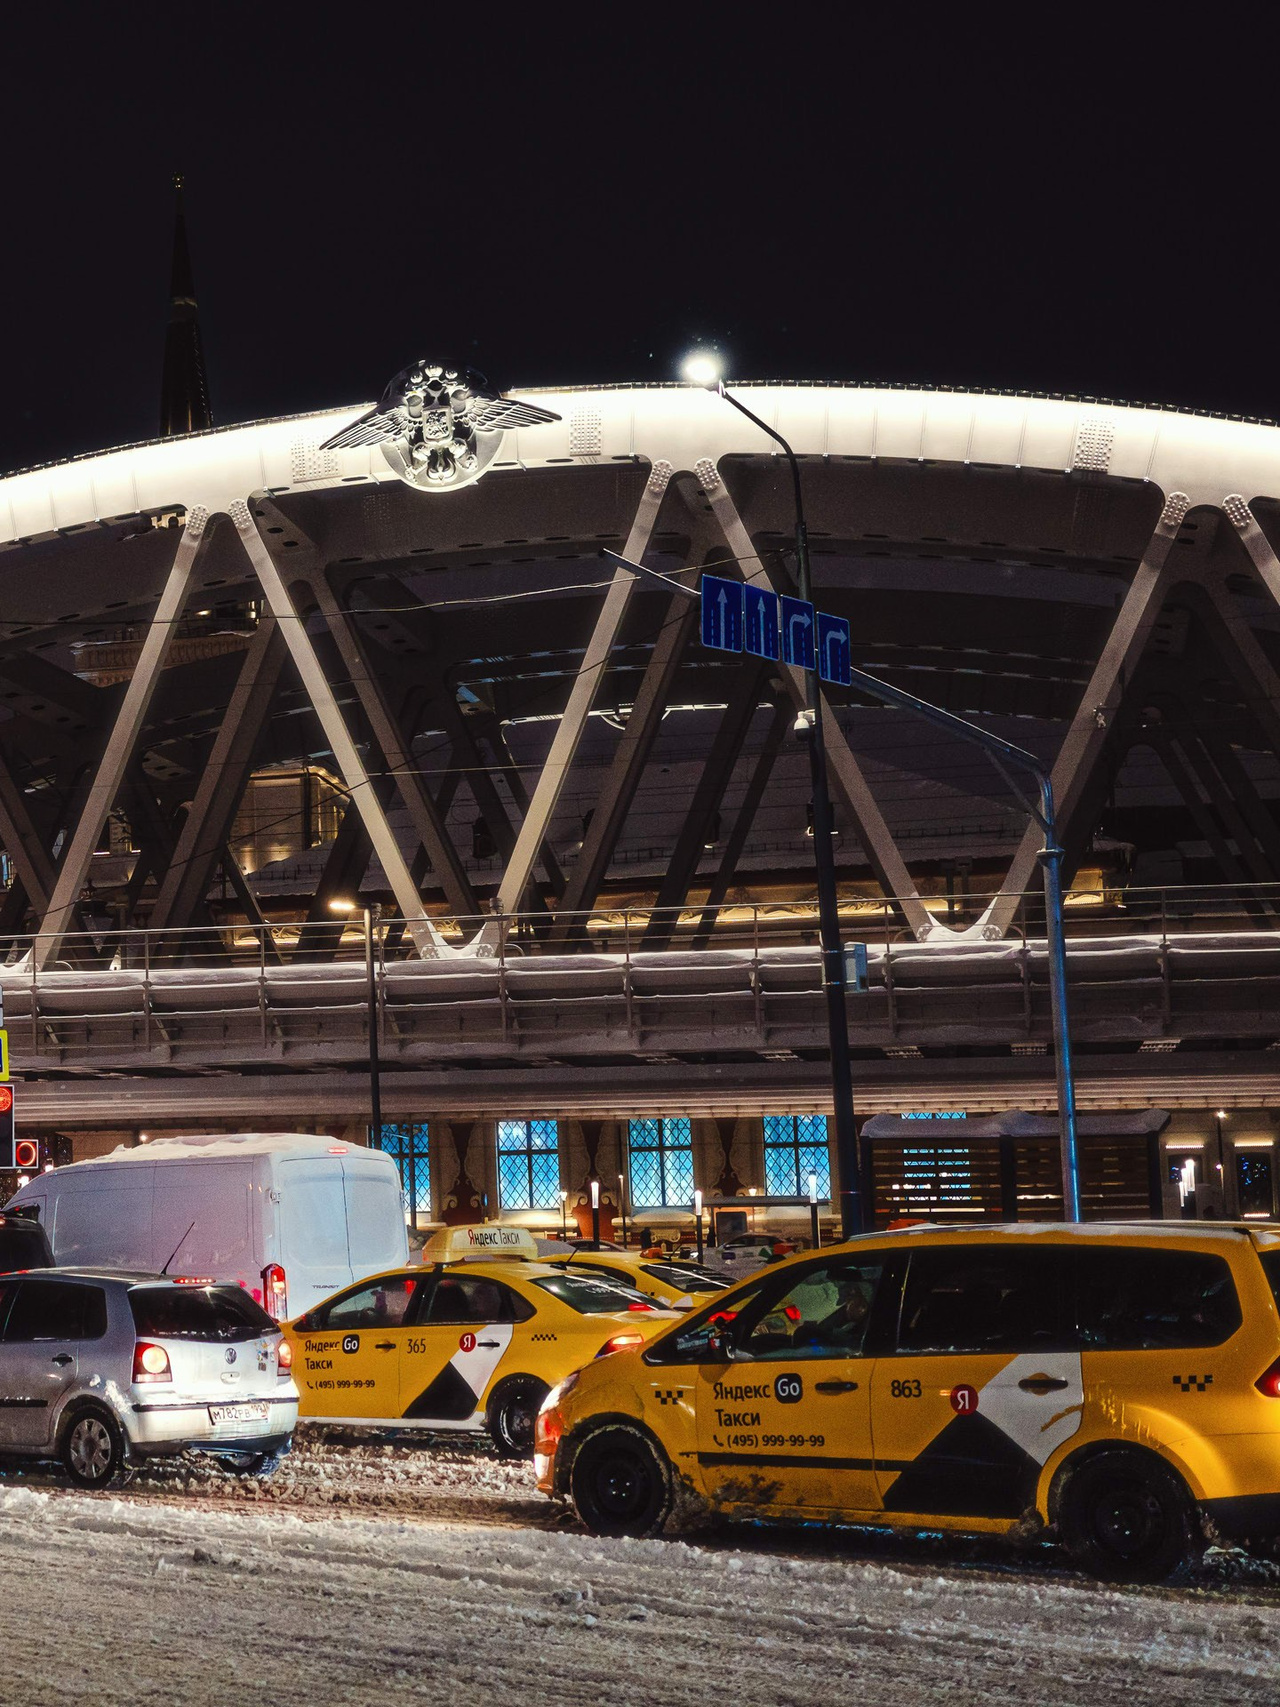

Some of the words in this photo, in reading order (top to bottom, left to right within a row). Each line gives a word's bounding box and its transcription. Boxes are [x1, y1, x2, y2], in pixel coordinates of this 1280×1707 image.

[467, 1229, 498, 1247] Яндекс
[497, 1228, 521, 1245] Такси
[305, 1340, 340, 1352] Яндекс
[343, 1337, 358, 1351] Go
[407, 1338, 426, 1353] 365
[305, 1358, 333, 1370] Такси
[315, 1380, 335, 1391] (495)
[336, 1379, 376, 1389] 999-99-99
[713, 1382, 771, 1401] Яндекс
[776, 1377, 801, 1397] Go
[891, 1379, 922, 1398] 863
[957, 1390, 970, 1410] Я
[714, 1408, 761, 1427] Такси
[727, 1434, 759, 1449] (495)
[761, 1434, 825, 1447] 999-99-99
